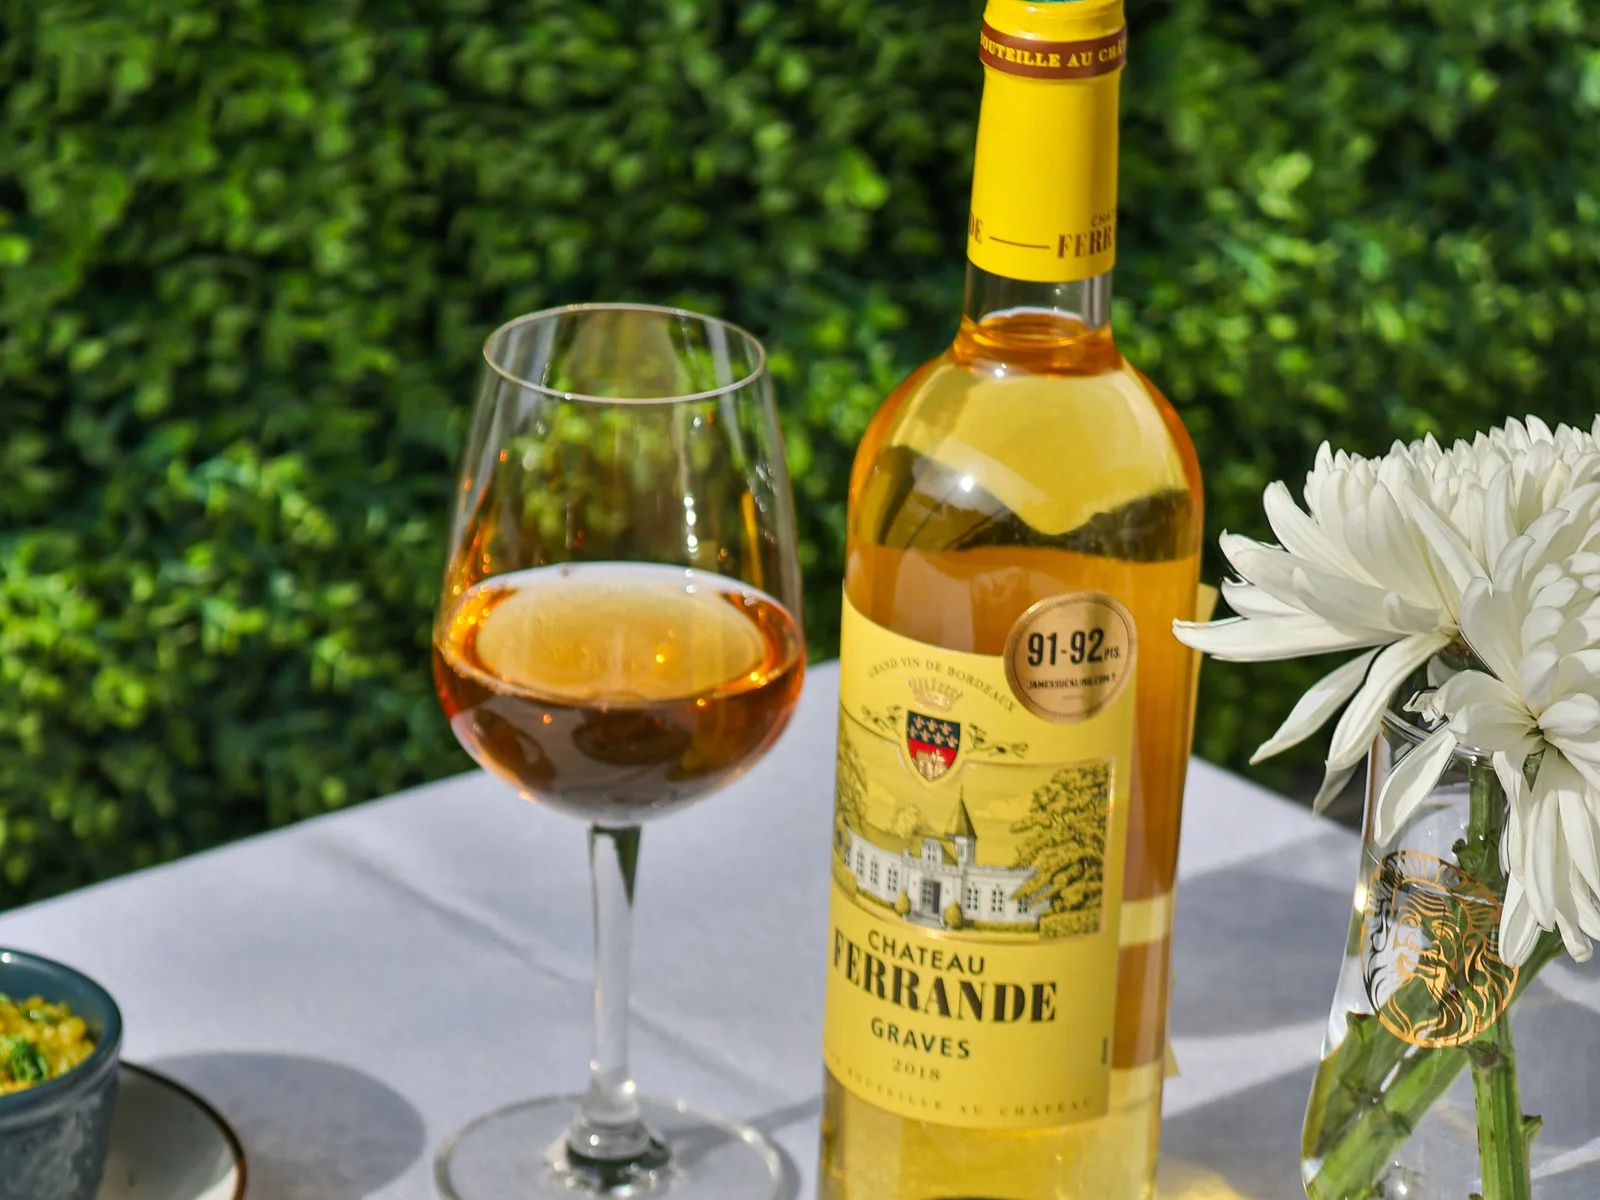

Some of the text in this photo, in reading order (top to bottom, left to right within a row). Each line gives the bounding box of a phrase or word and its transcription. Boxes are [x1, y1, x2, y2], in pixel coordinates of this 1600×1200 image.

[1066, 52, 1092, 67] AU
[868, 657, 1015, 713] GRAND VIN DE BORDEAUX
[833, 926, 1058, 1024] FERRANDE
[868, 929, 986, 976] CHATEAU
[871, 1017, 971, 1060] GRAVES
[892, 1058, 940, 1081] 2018
